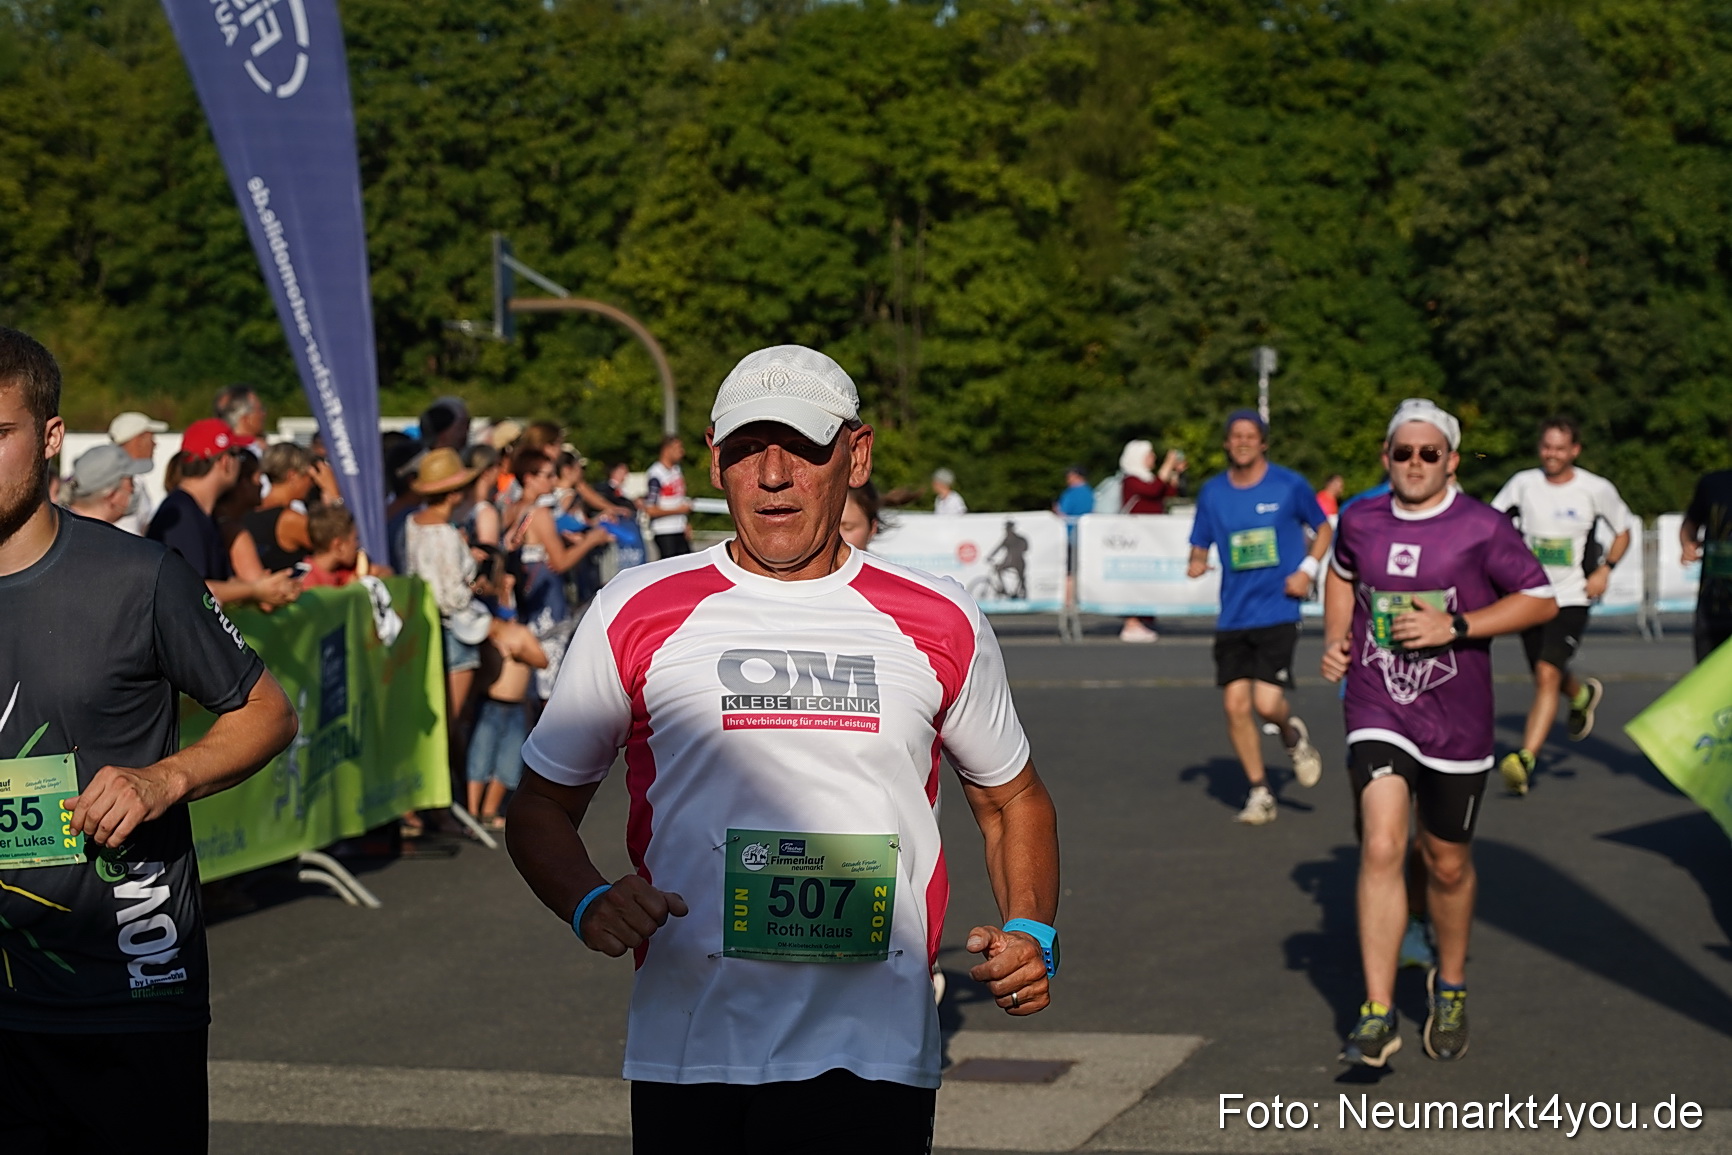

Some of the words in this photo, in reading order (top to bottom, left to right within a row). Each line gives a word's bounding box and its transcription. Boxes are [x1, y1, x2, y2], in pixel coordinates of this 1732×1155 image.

[717, 648, 879, 697] OM
[727, 718, 745, 727] Ihre
[746, 717, 799, 727] Verbindung
[799, 717, 813, 727] für
[814, 718, 838, 727] mehr
[839, 718, 877, 731] Leistung
[15, 834, 56, 848] Lukas
[770, 855, 825, 865] Firmenlauf
[733, 888, 749, 932] RUN
[767, 876, 857, 920] 507
[870, 885, 888, 943] 2022
[767, 922, 804, 937] Roth
[809, 923, 853, 938] Klaus
